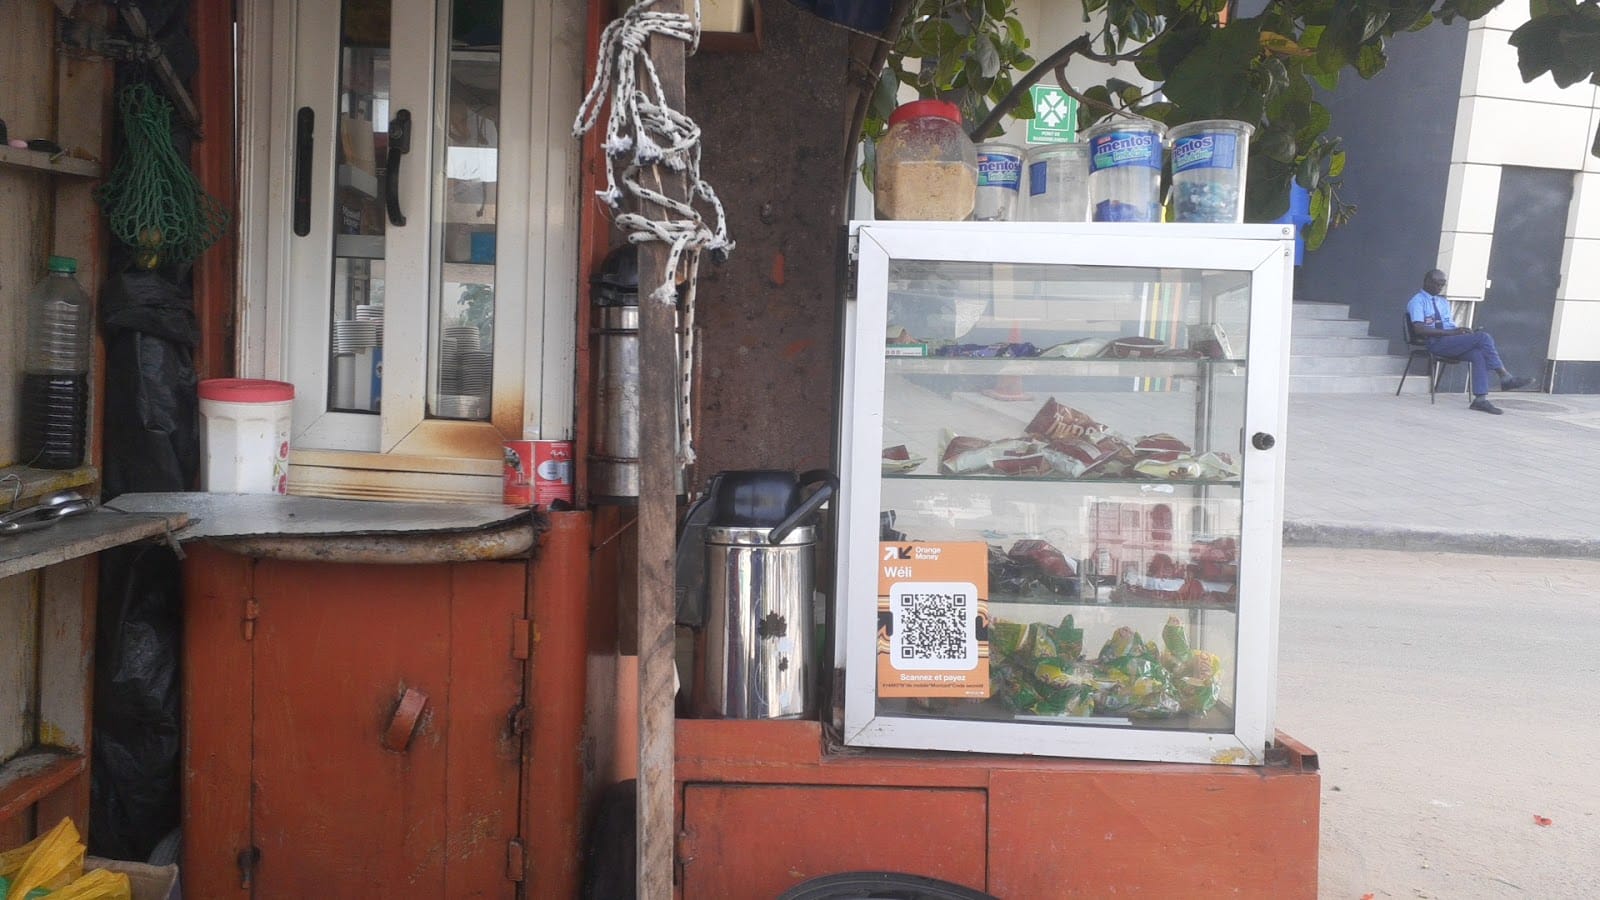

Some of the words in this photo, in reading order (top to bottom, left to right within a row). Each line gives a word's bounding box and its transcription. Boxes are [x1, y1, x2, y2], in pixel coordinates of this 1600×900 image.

[1098, 136, 1152, 153] mentos
[915, 546, 941, 554] Orange
[884, 566, 912, 577] Wéli
[900, 673, 932, 681] Scannez
[934, 673, 942, 681] et
[943, 674, 966, 682] payez
